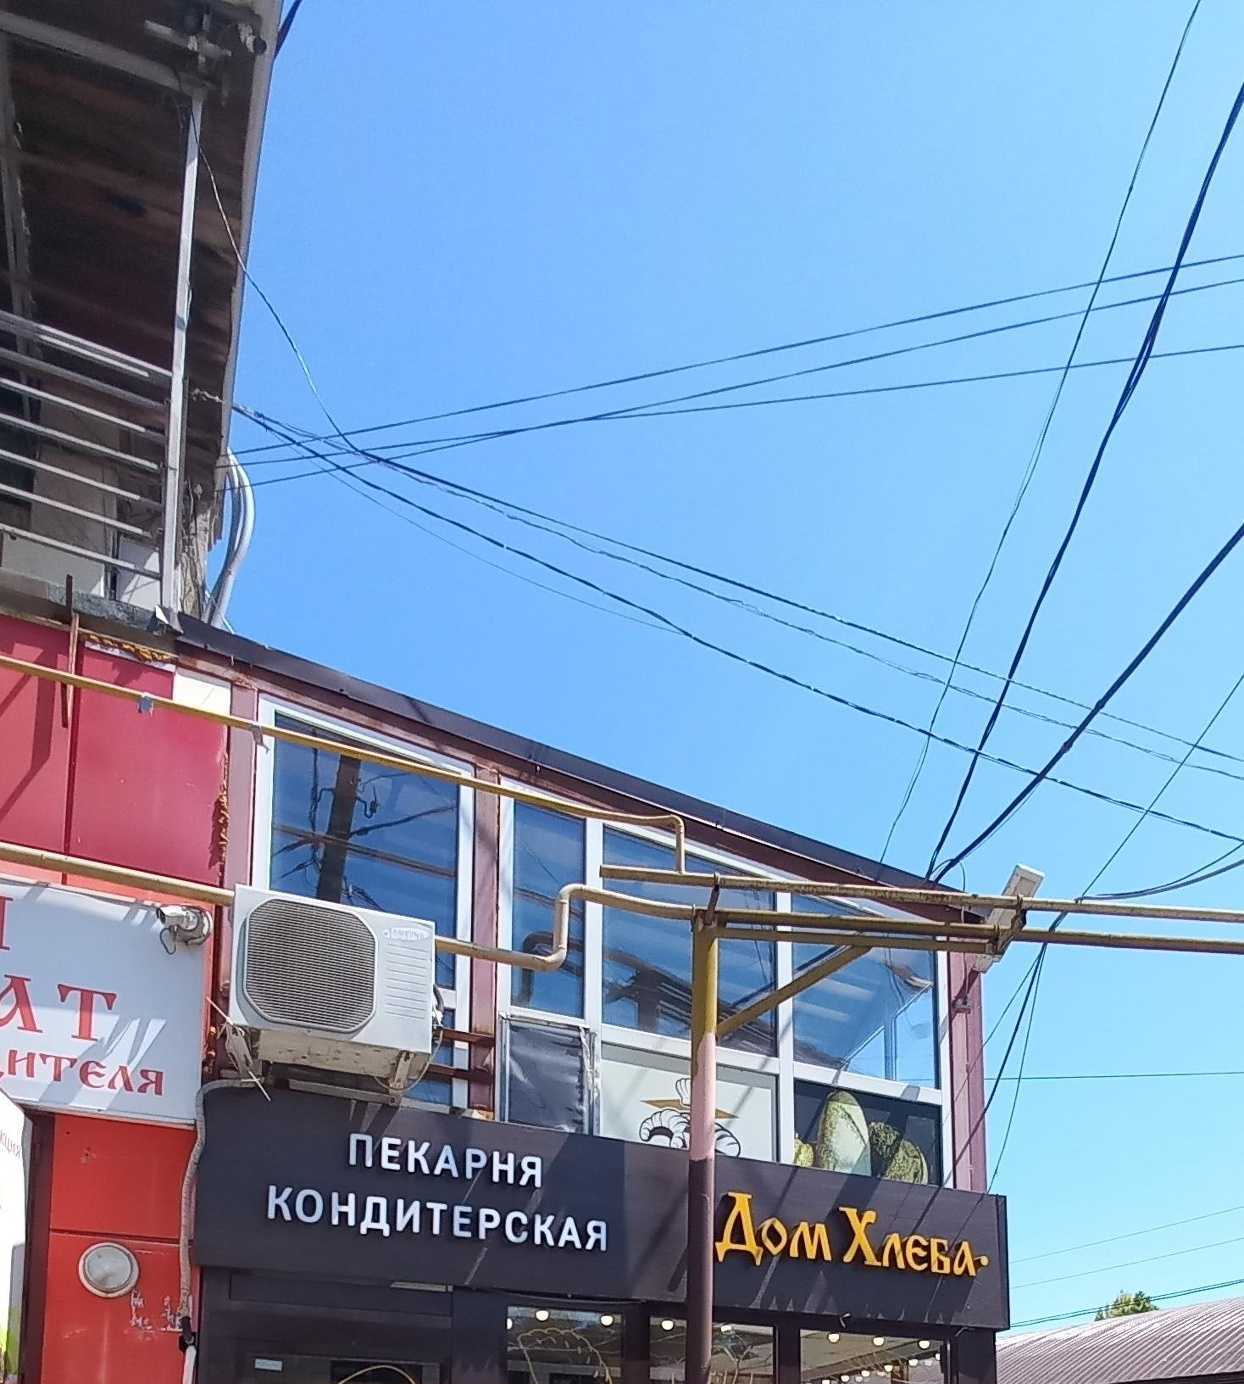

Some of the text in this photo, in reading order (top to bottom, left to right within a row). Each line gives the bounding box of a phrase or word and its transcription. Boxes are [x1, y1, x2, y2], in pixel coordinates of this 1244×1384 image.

[0, 1049, 164, 1097] ИТЕЛЯ
[348, 1132, 543, 1189] ПЕКАРНЯ
[266, 1184, 608, 1252] КОНДИТЕРСКАЯ
